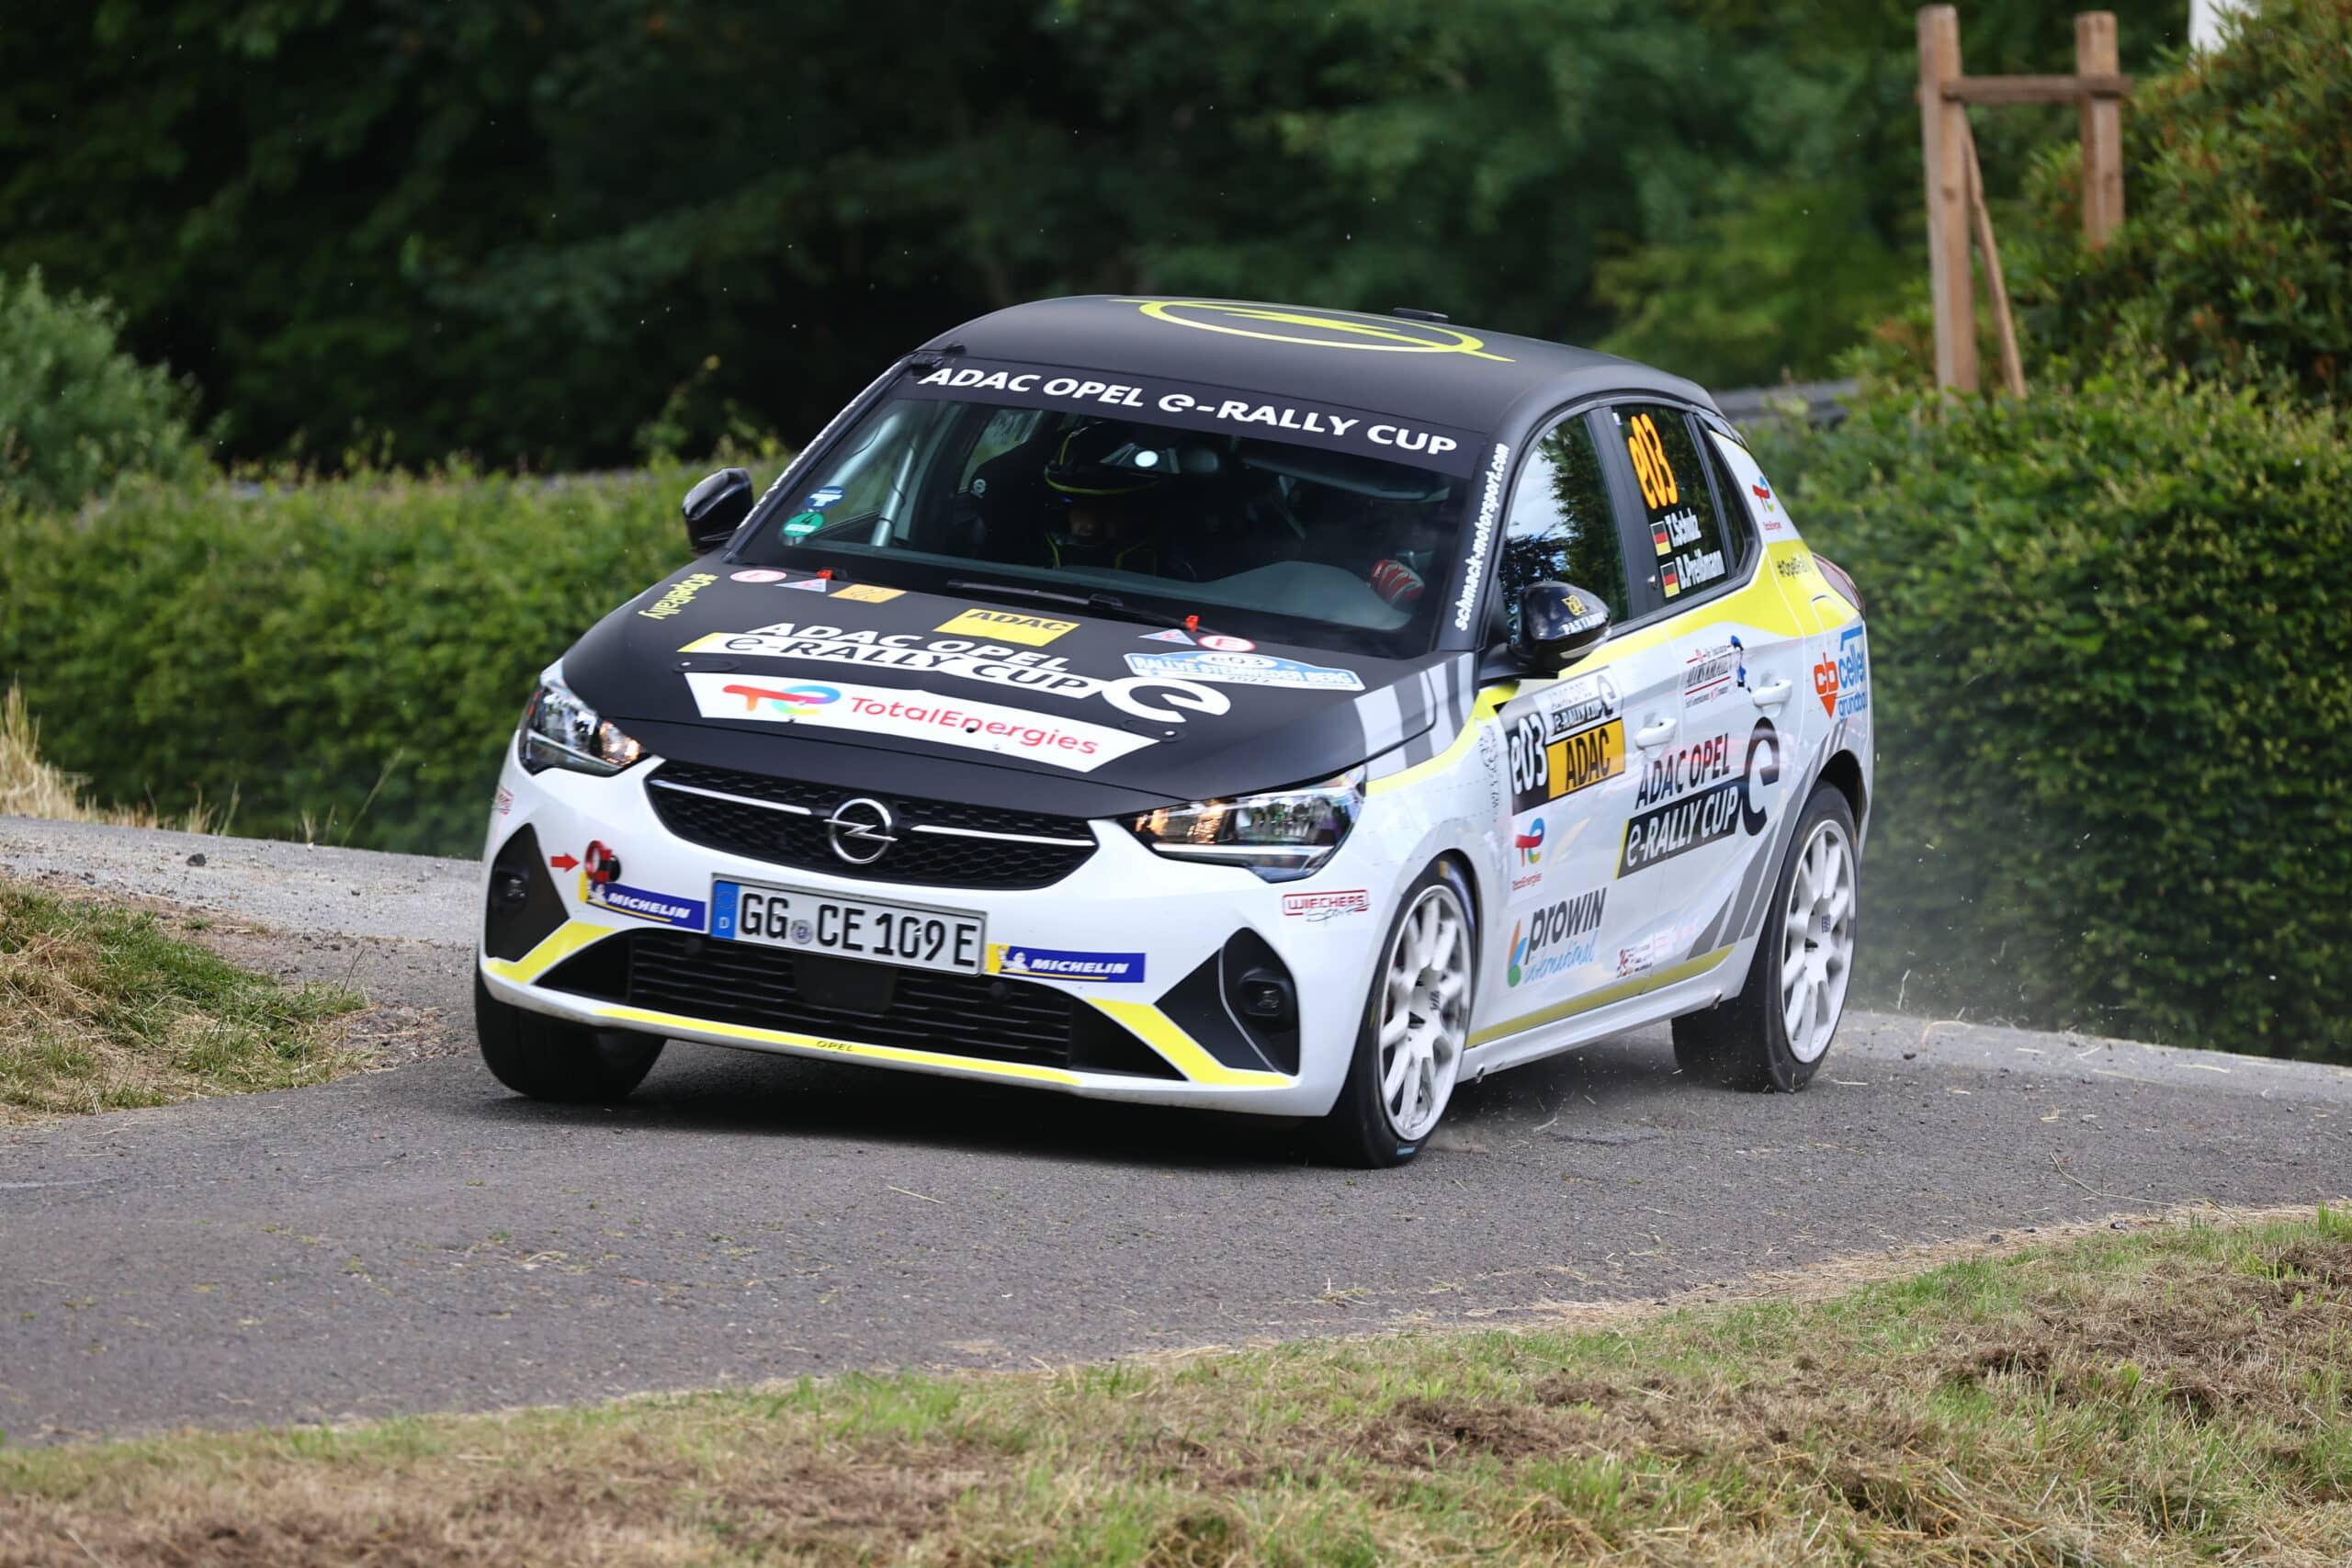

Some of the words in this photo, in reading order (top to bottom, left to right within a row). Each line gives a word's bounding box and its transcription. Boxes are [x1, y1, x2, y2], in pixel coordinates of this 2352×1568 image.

[918, 367, 1041, 393] ADAC
[1043, 378, 1144, 408] OPEL
[1159, 393, 1359, 437] e-RALLY
[1367, 423, 1458, 456] CUP
[1628, 413, 1679, 510] e03
[1455, 443, 1510, 631] schmack-motorsport.com
[638, 573, 719, 620] #OpelRally
[968, 610, 1069, 633] ADAC
[726, 637, 961, 669] e-RALLY
[973, 663, 1089, 691] CUP
[745, 623, 920, 649] ADAC
[927, 638, 1071, 672] OPEL
[851, 697, 1099, 754] TotalEnergies
[1509, 714, 1549, 795] e03
[1566, 727, 1610, 791] ADAC
[1635, 750, 1685, 809] ADAC
[1690, 733, 1728, 787] OPEL
[1627, 800, 1702, 866] e-RALLY
[1702, 786, 1737, 838] CUP
[608, 893, 691, 919] MICHELIN
[719, 917, 729, 929] D
[741, 893, 789, 939] GG
[1031, 958, 1129, 975] MICHELIN
[816, 1041, 854, 1052] OPEL
